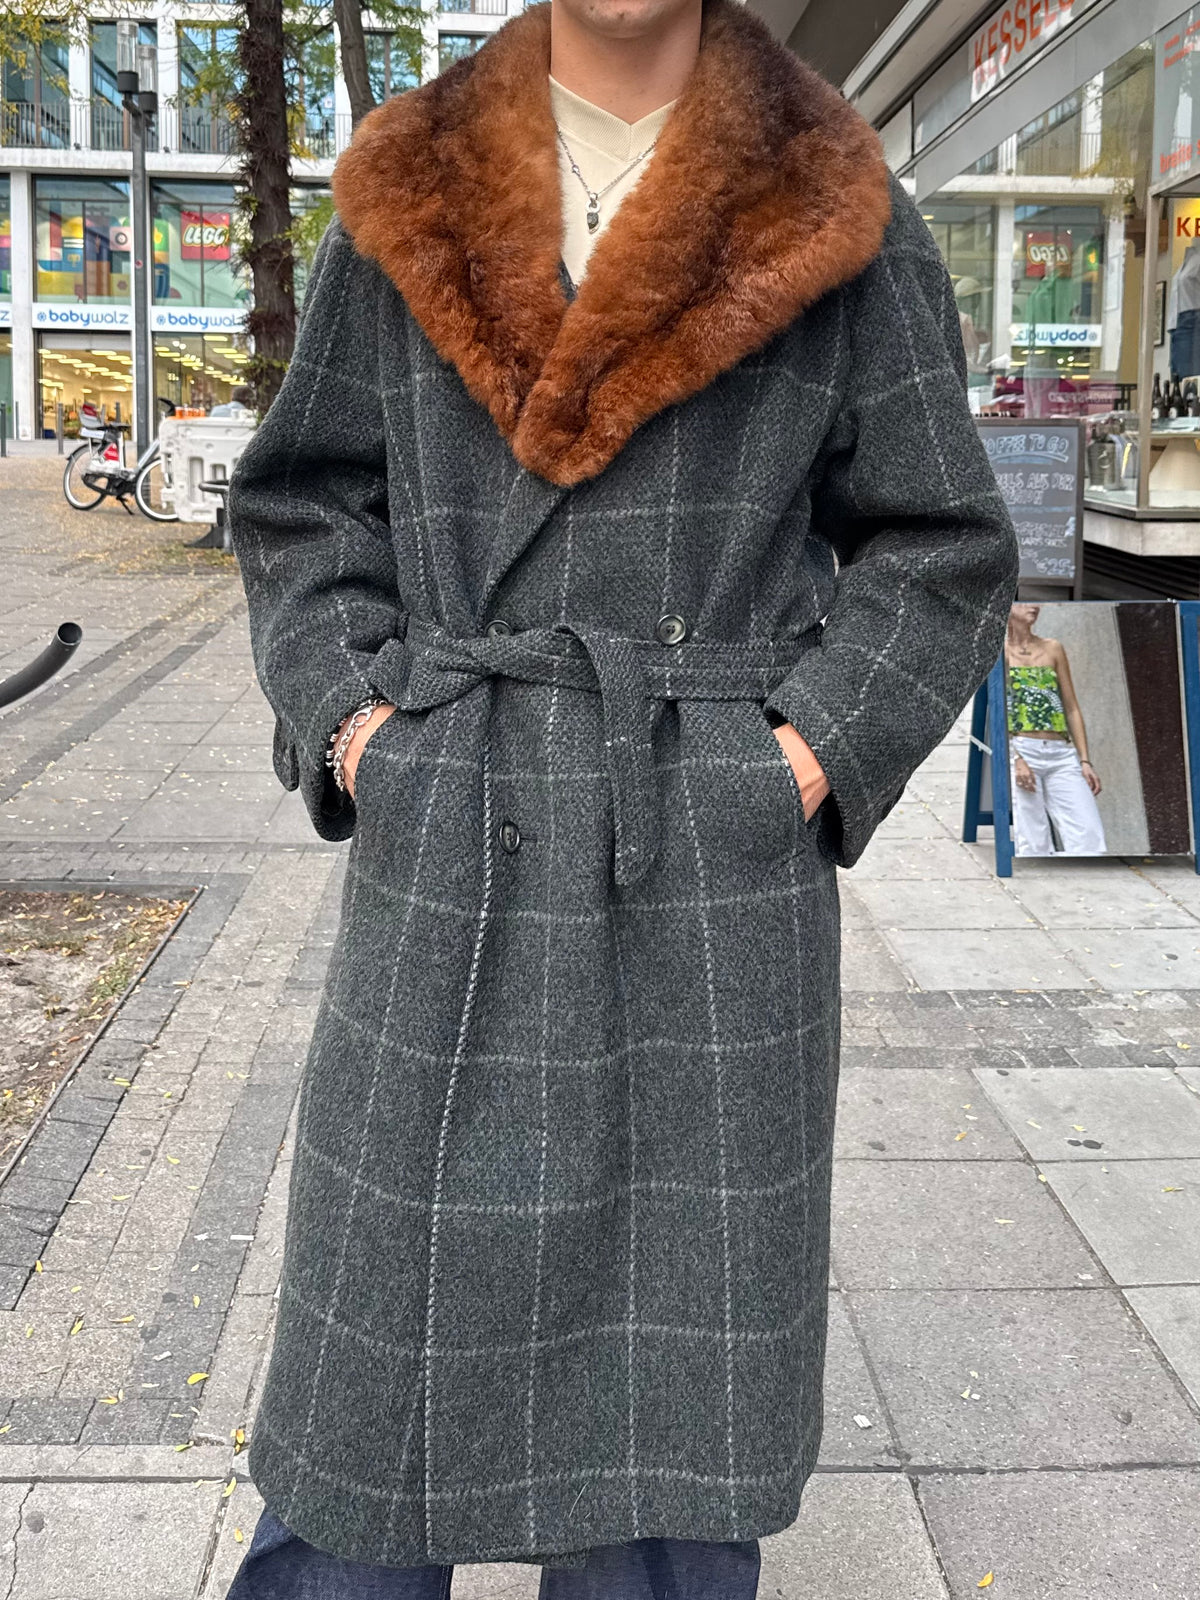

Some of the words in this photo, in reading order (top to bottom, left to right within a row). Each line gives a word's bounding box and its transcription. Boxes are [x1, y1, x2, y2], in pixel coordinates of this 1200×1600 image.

[974, 0, 1074, 85] KESSEL
[185, 226, 227, 245] LEGO
[49, 310, 129, 326] babywalz
